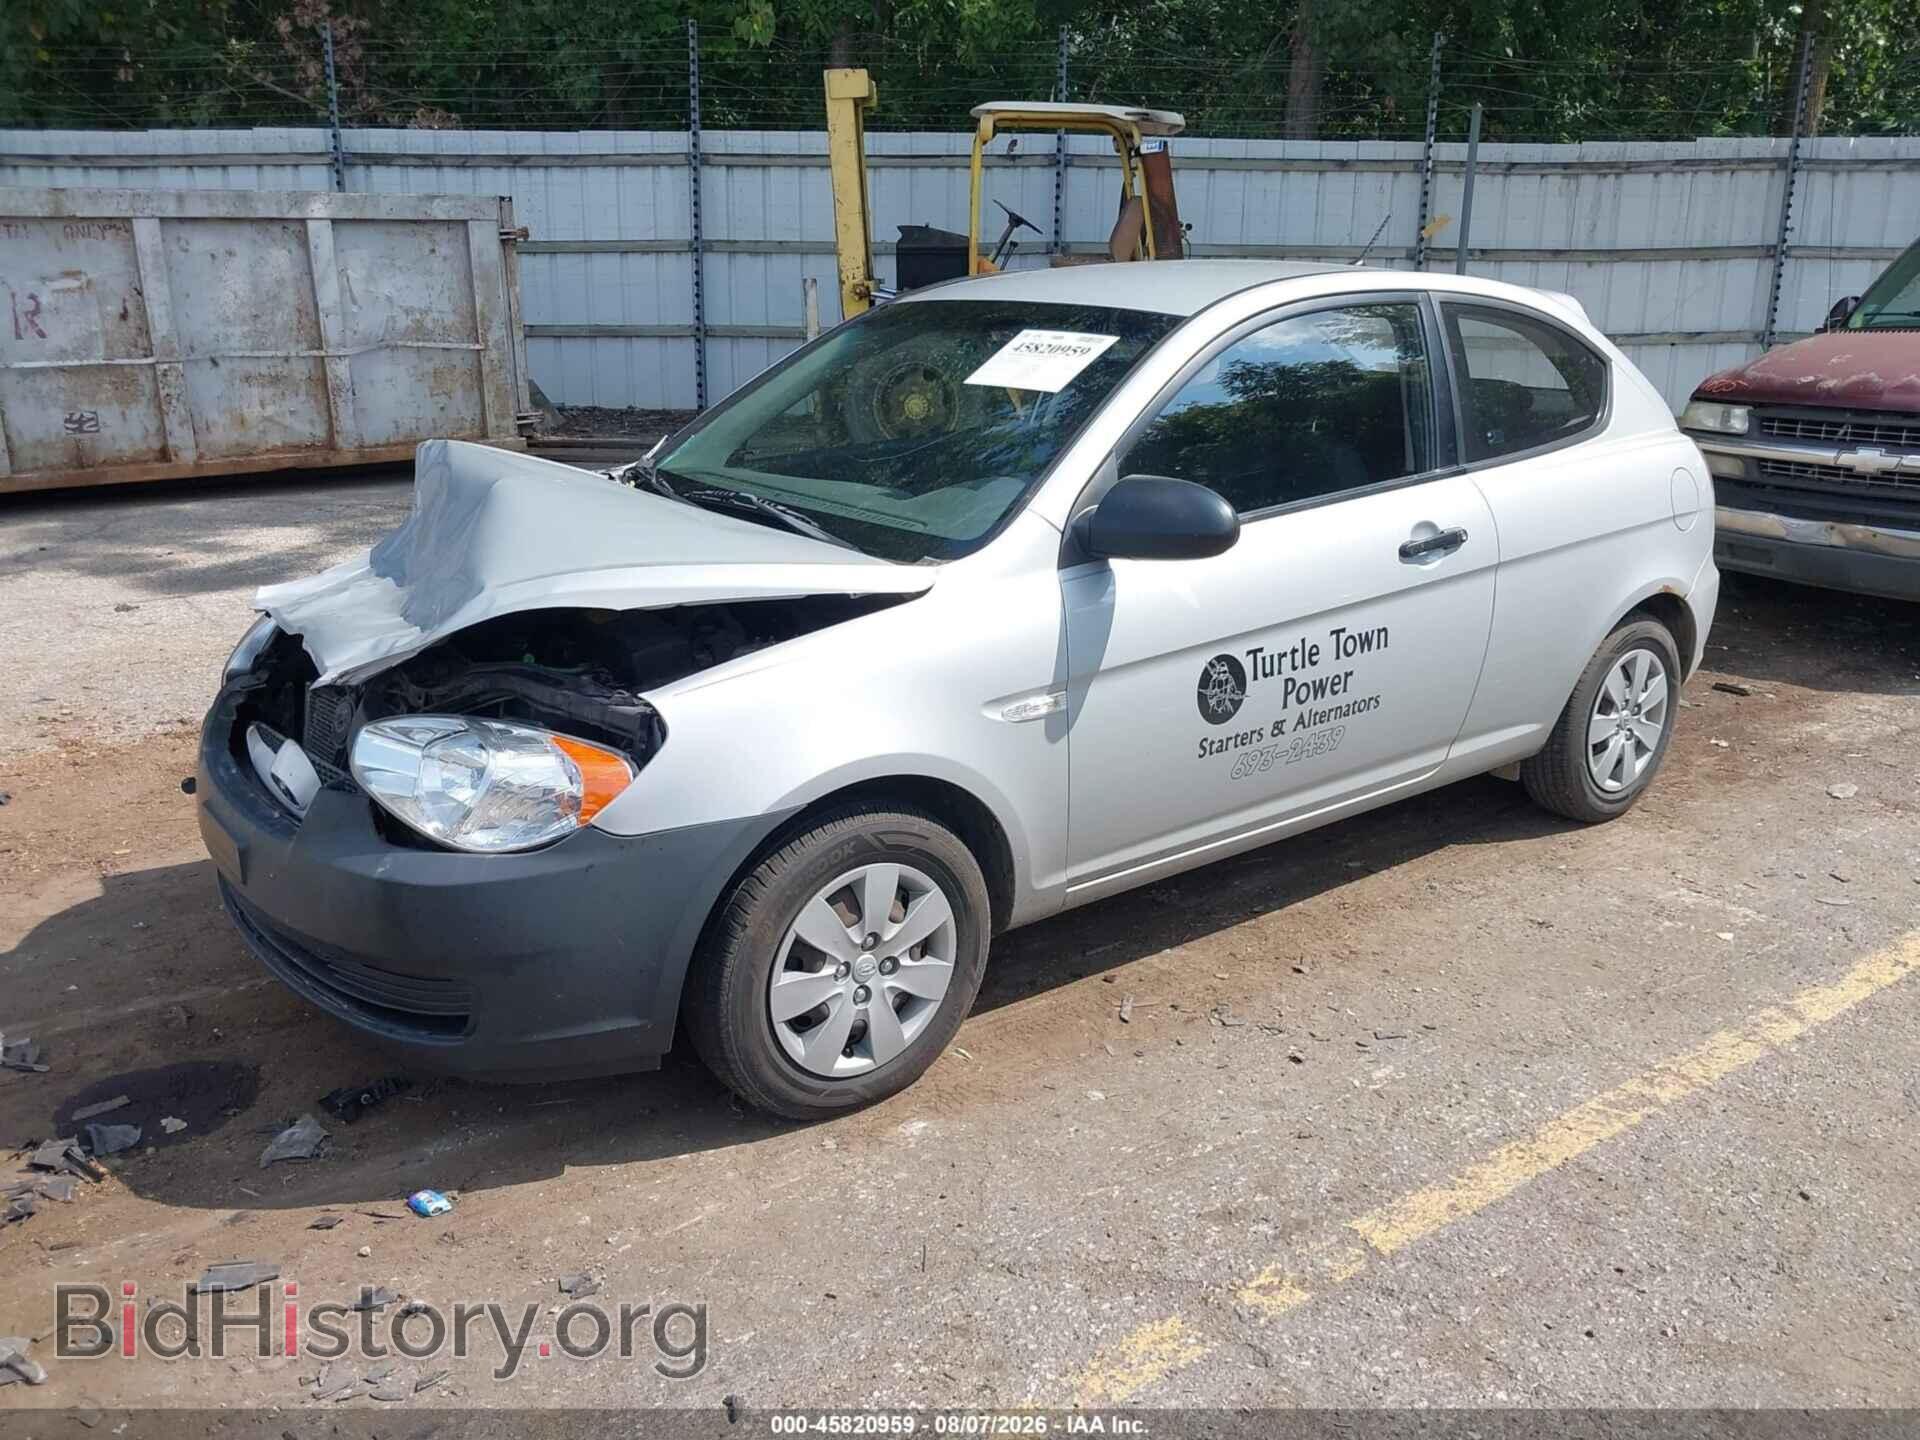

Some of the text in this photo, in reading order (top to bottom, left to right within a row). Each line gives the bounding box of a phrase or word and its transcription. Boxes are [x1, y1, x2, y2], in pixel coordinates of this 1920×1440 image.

[1012, 342, 1092, 357] 45820959
[1246, 626, 1389, 681] Turtle Town
[1282, 670, 1354, 710] Power
[1198, 695, 1381, 759] Starters & Alternators
[1230, 725, 1346, 780] 693-2439
